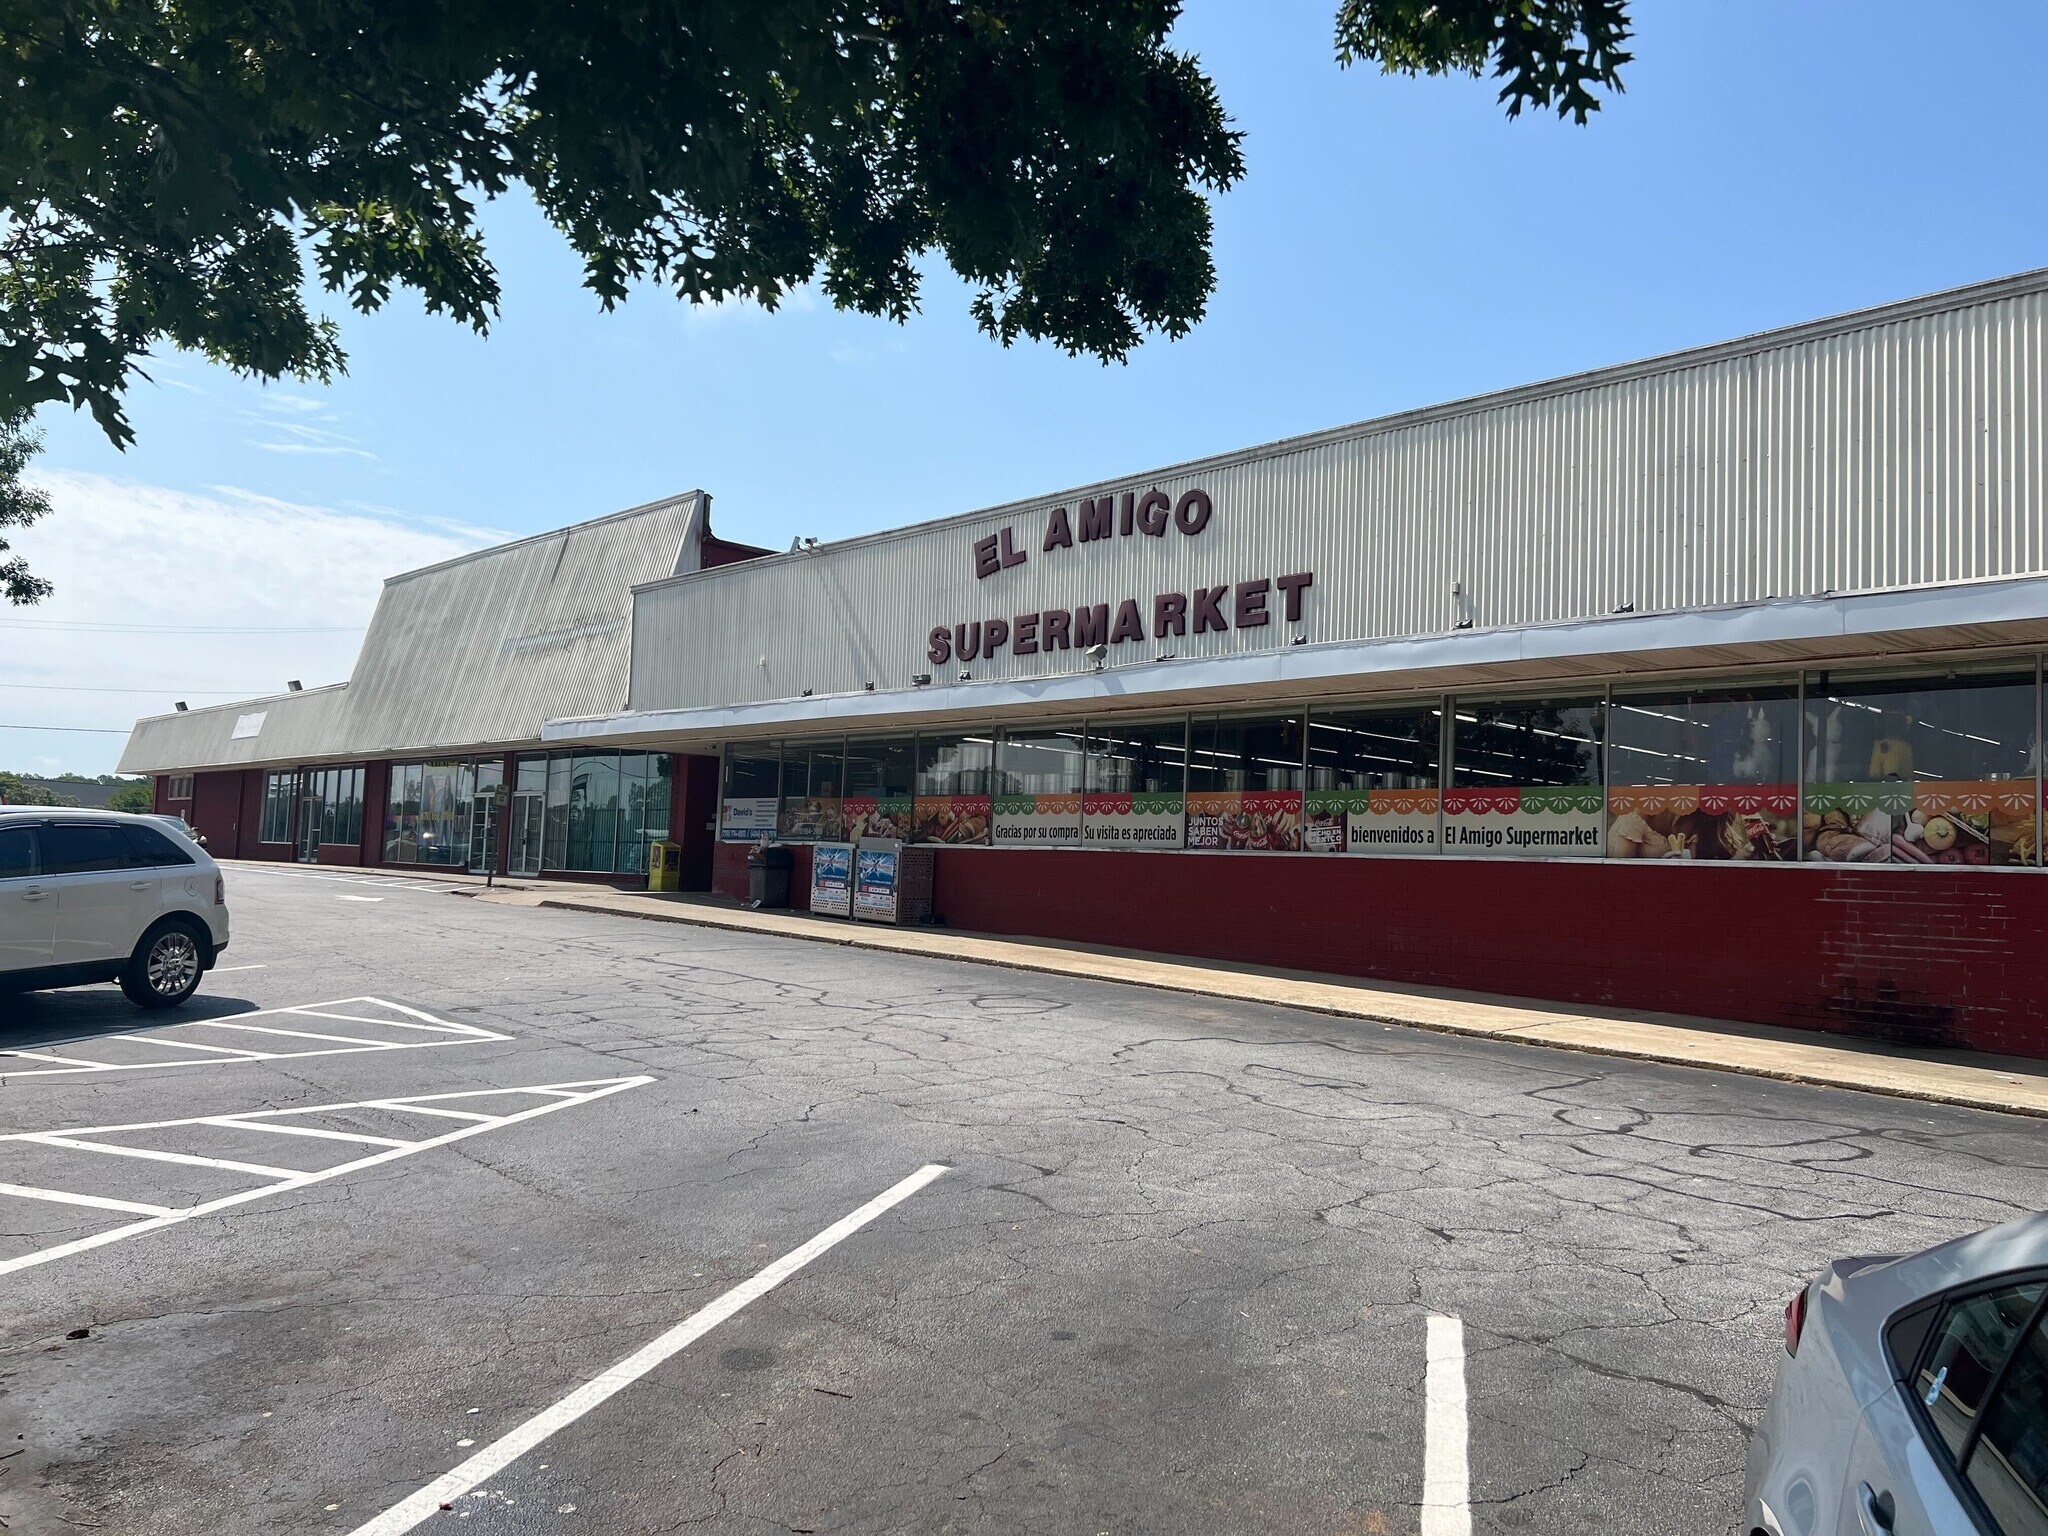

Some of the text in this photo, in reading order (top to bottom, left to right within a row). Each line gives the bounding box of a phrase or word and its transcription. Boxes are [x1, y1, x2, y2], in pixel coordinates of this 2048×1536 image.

[974, 487, 1212, 580] EL AMIGO
[927, 572, 1313, 664] SUPERMARKET
[733, 808, 752, 817] David's
[1188, 817, 1224, 826] JUNTOS
[995, 824, 1078, 840] Gracias por su compra
[1084, 825, 1177, 842] Su visita es apreciada
[1188, 827, 1217, 836] SABEN
[1351, 826, 1434, 843] bienvenidos a
[1445, 826, 1598, 848] El Amigo Supermarket
[1188, 837, 1218, 846] MEJOR
